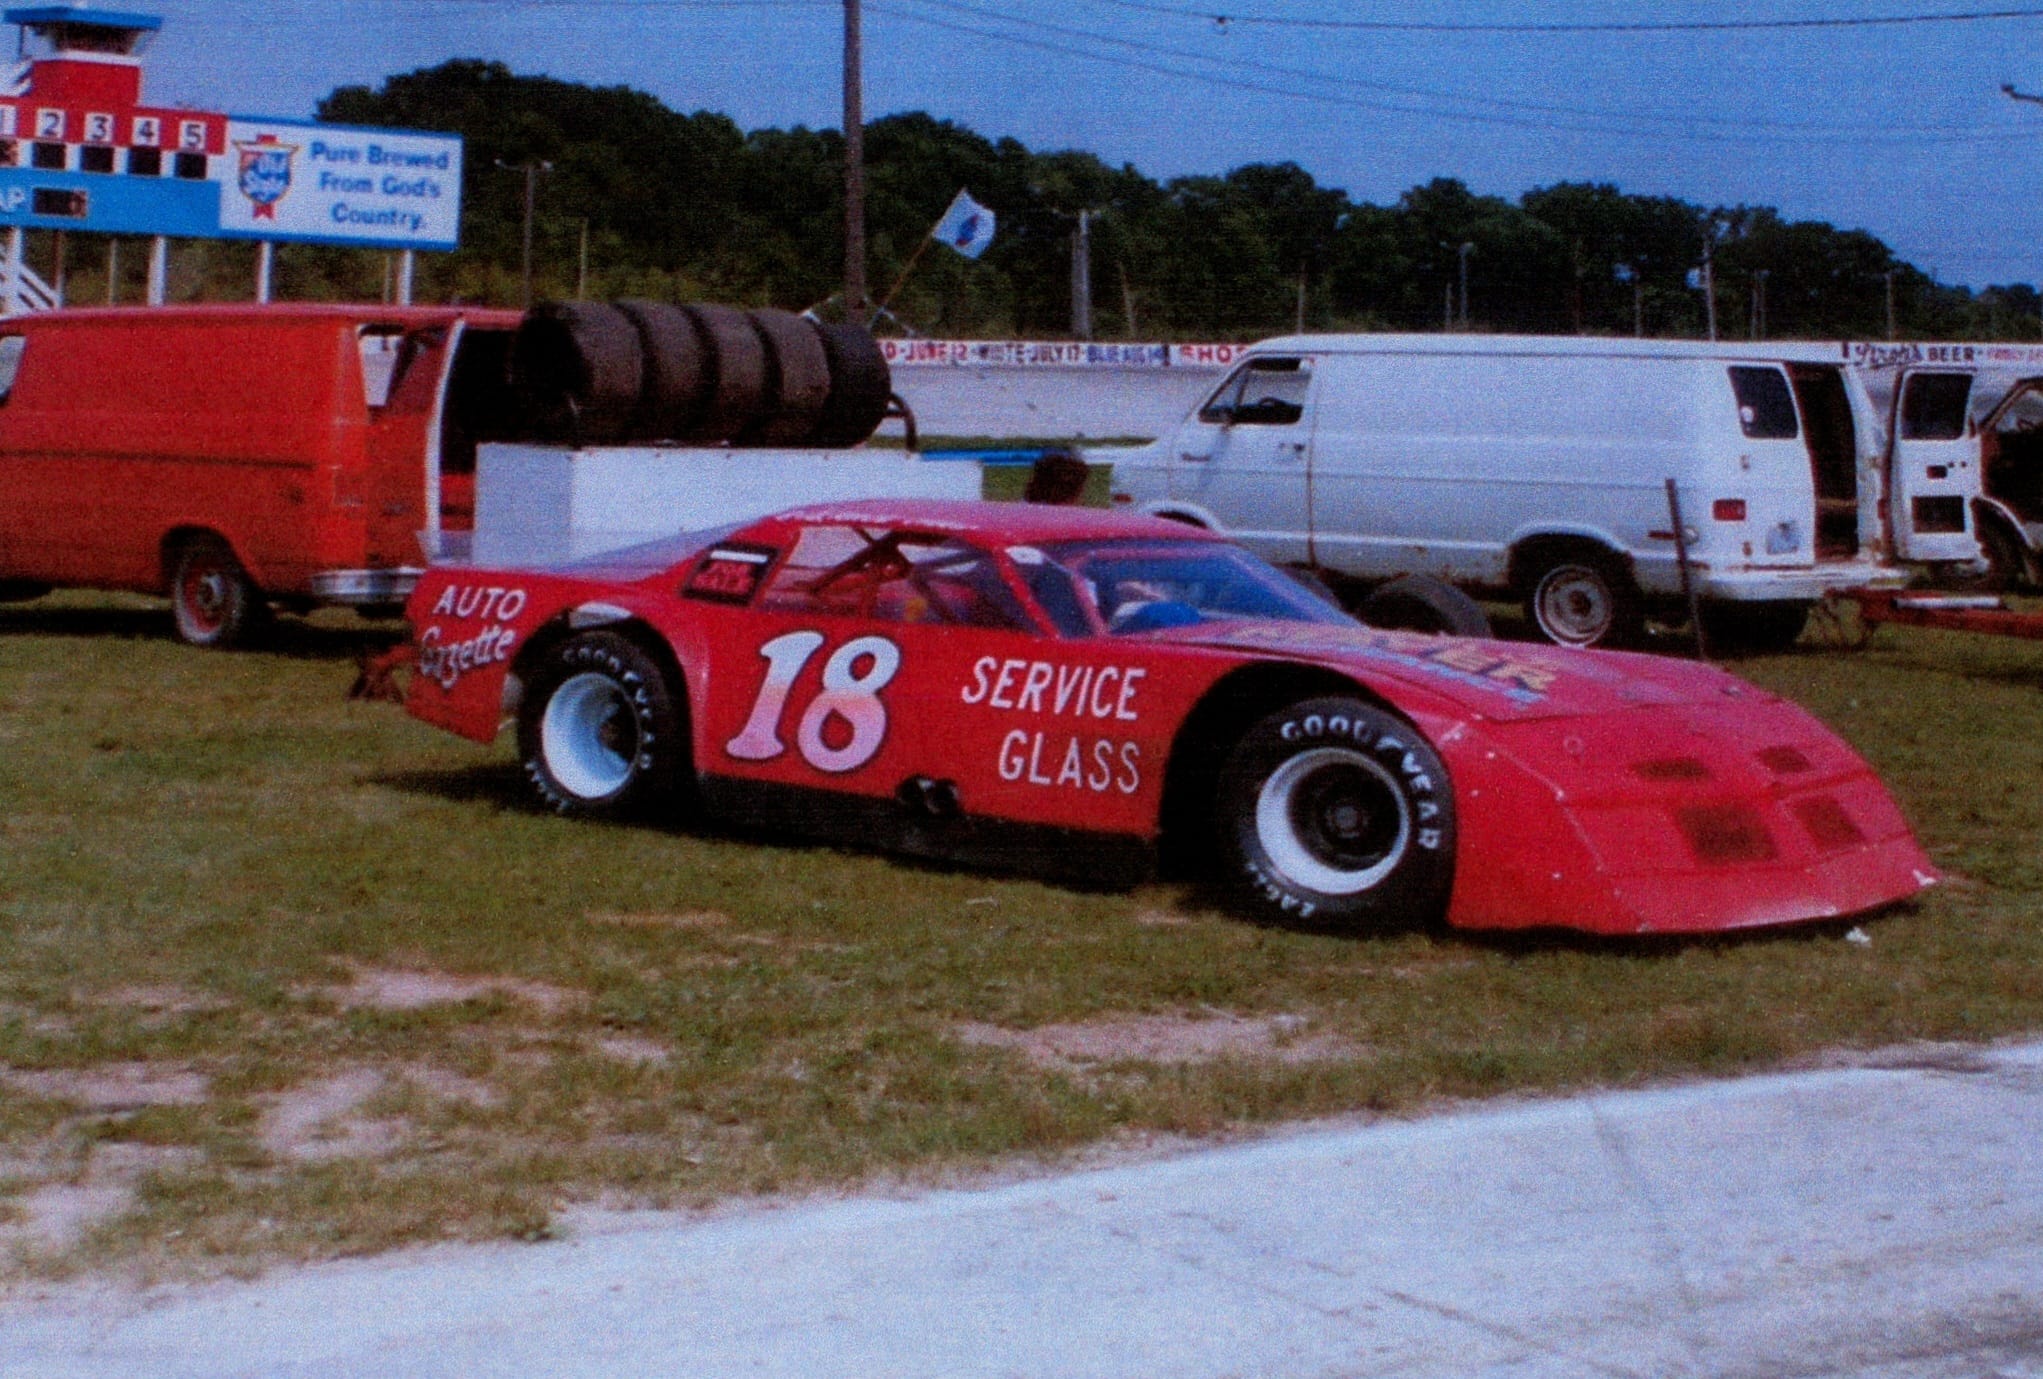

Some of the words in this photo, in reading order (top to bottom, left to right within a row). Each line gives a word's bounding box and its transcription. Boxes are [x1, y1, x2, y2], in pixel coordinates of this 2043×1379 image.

[43, 113, 60, 136] 2
[92, 116, 108, 140] 3
[138, 120, 154, 139] 4
[185, 124, 201, 146] 5
[310, 141, 360, 162] Pure
[368, 145, 449, 170] Brewed
[320, 171, 373, 192] From
[382, 174, 440, 198] God's
[1928, 347, 1975, 362] BEER
[432, 585, 526, 620] AUTO
[726, 631, 900, 772] 18
[962, 656, 1146, 720] SERVICE
[1000, 730, 1141, 793] GLASS
[1281, 714, 1439, 850] GOODYEAR
